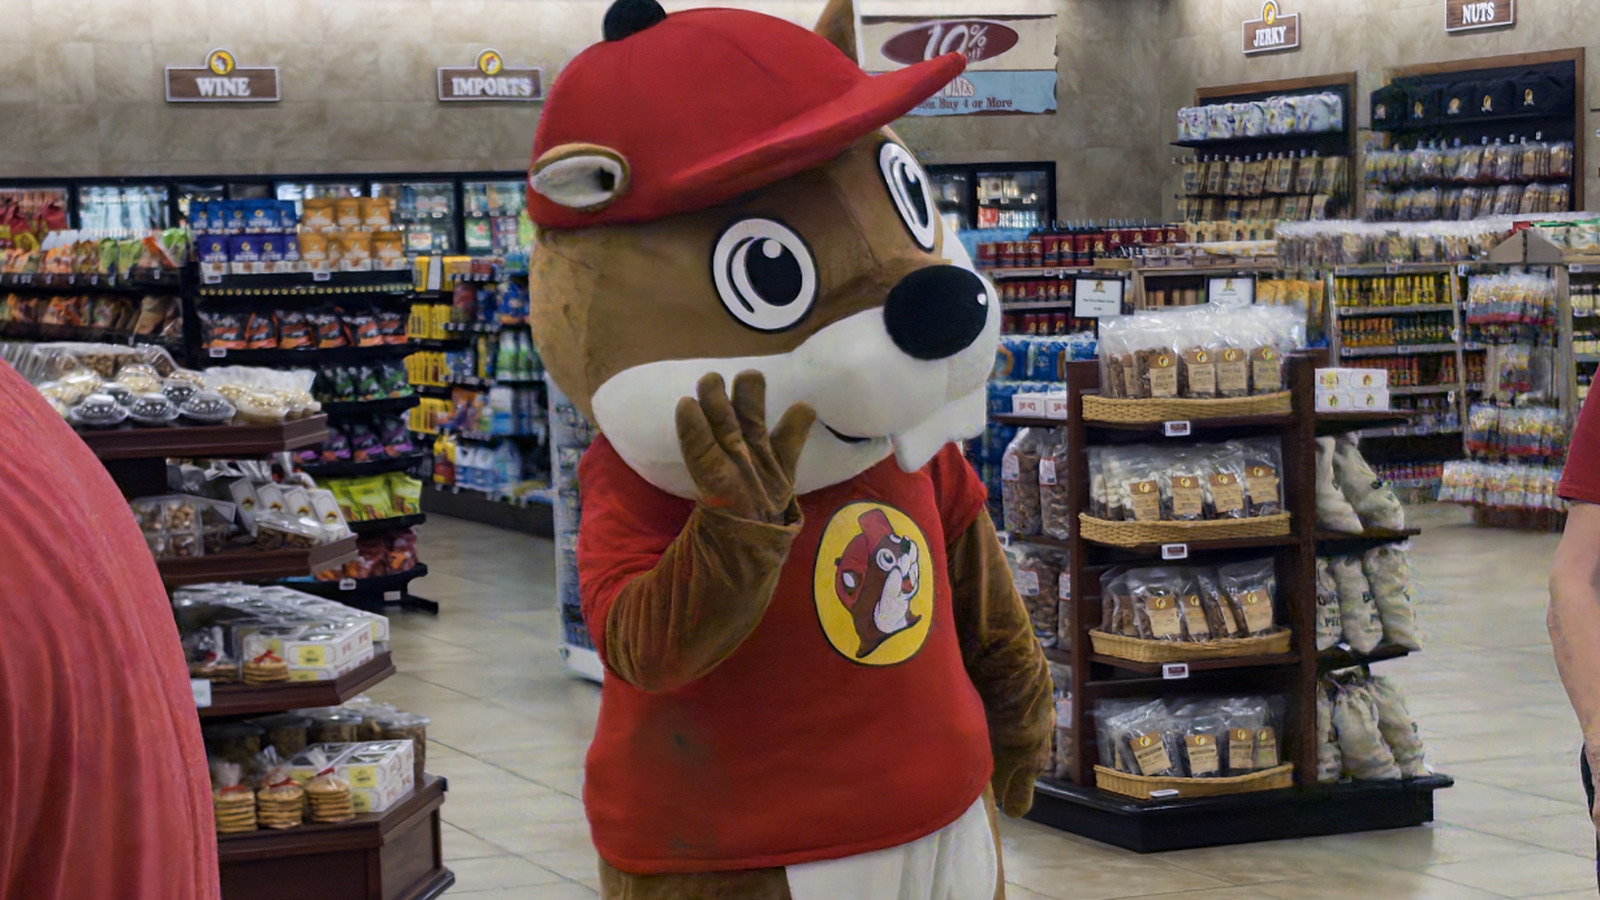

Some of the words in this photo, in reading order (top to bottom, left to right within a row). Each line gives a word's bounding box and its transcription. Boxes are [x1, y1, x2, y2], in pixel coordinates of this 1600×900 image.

[1462, 2, 1495, 24] NUTS
[924, 24, 988, 61] 10%
[1253, 25, 1287, 47] JERKY
[195, 76, 251, 97] WINE
[451, 77, 533, 96] IMPORTS
[940, 98, 959, 111] Buy
[962, 99, 969, 108] 4
[971, 100, 983, 108] or
[986, 97, 1013, 108] More
